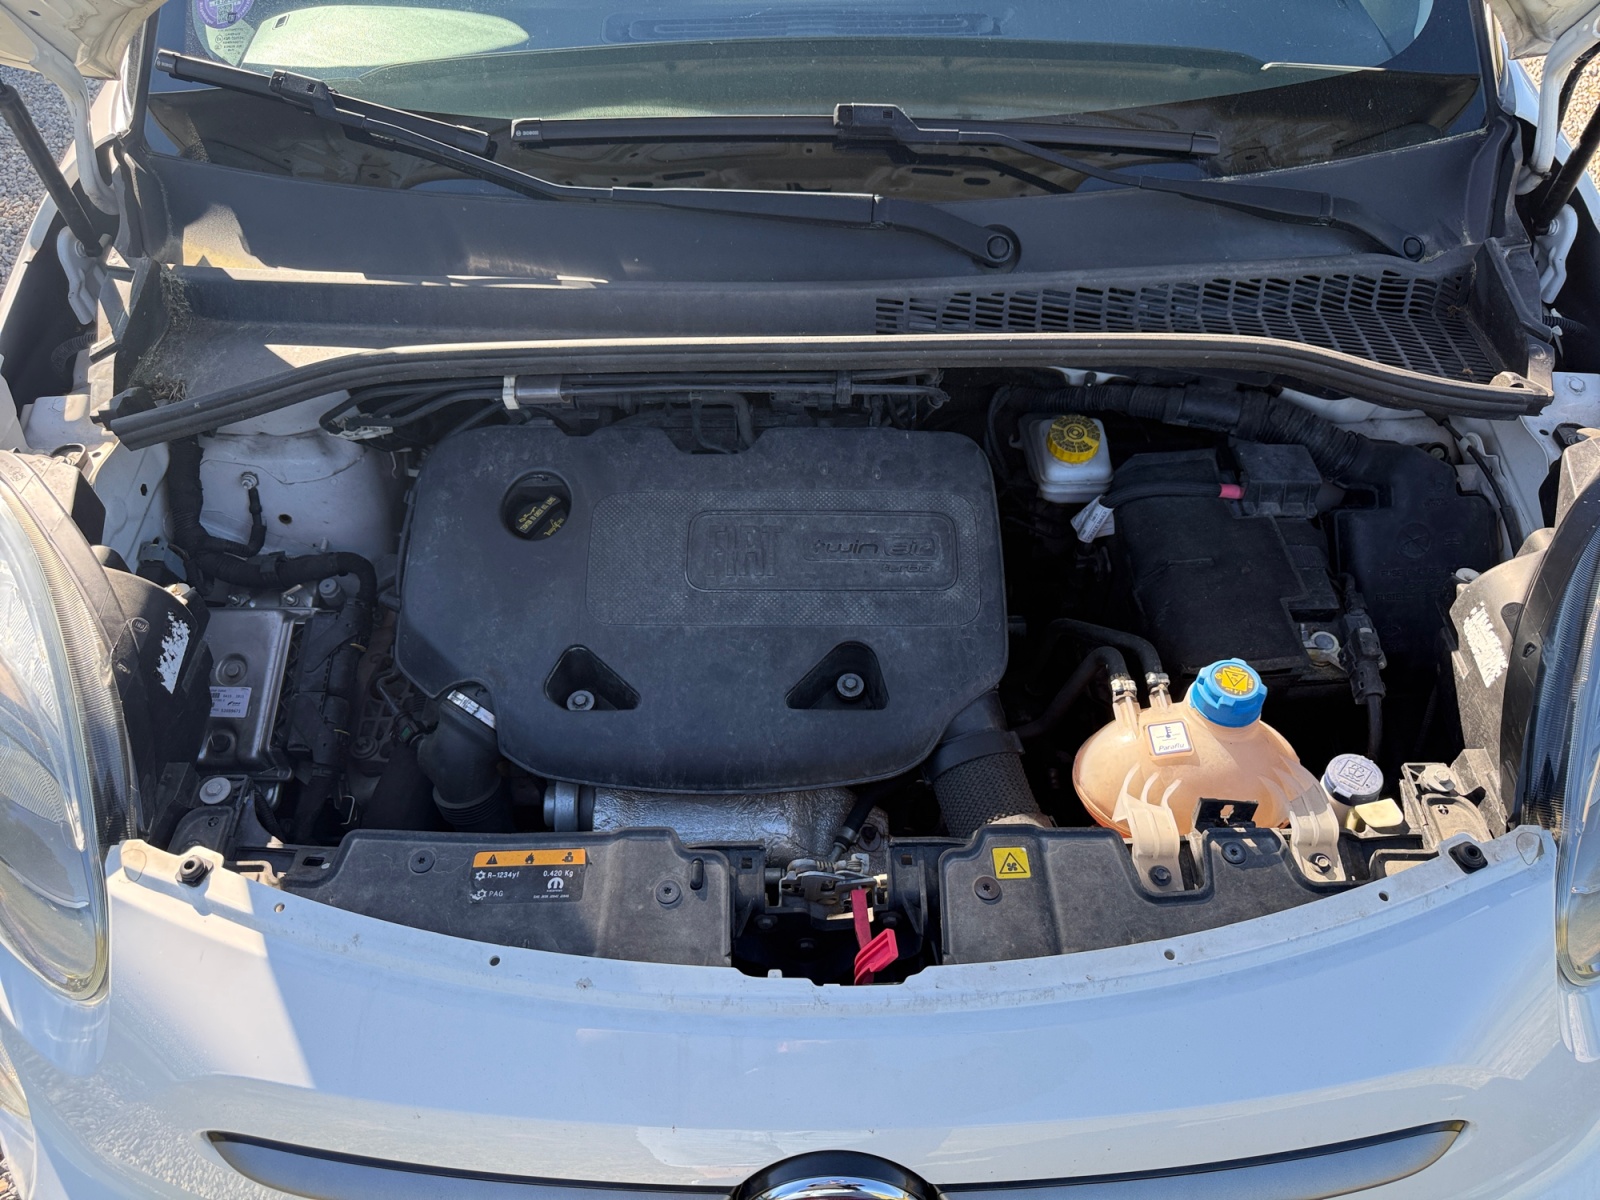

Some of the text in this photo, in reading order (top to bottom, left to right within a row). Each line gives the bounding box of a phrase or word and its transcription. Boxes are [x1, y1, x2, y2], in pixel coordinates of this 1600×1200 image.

[706, 525, 784, 577] FIAT
[814, 540, 879, 555] twin
[487, 871, 520, 880] R-1234yf
